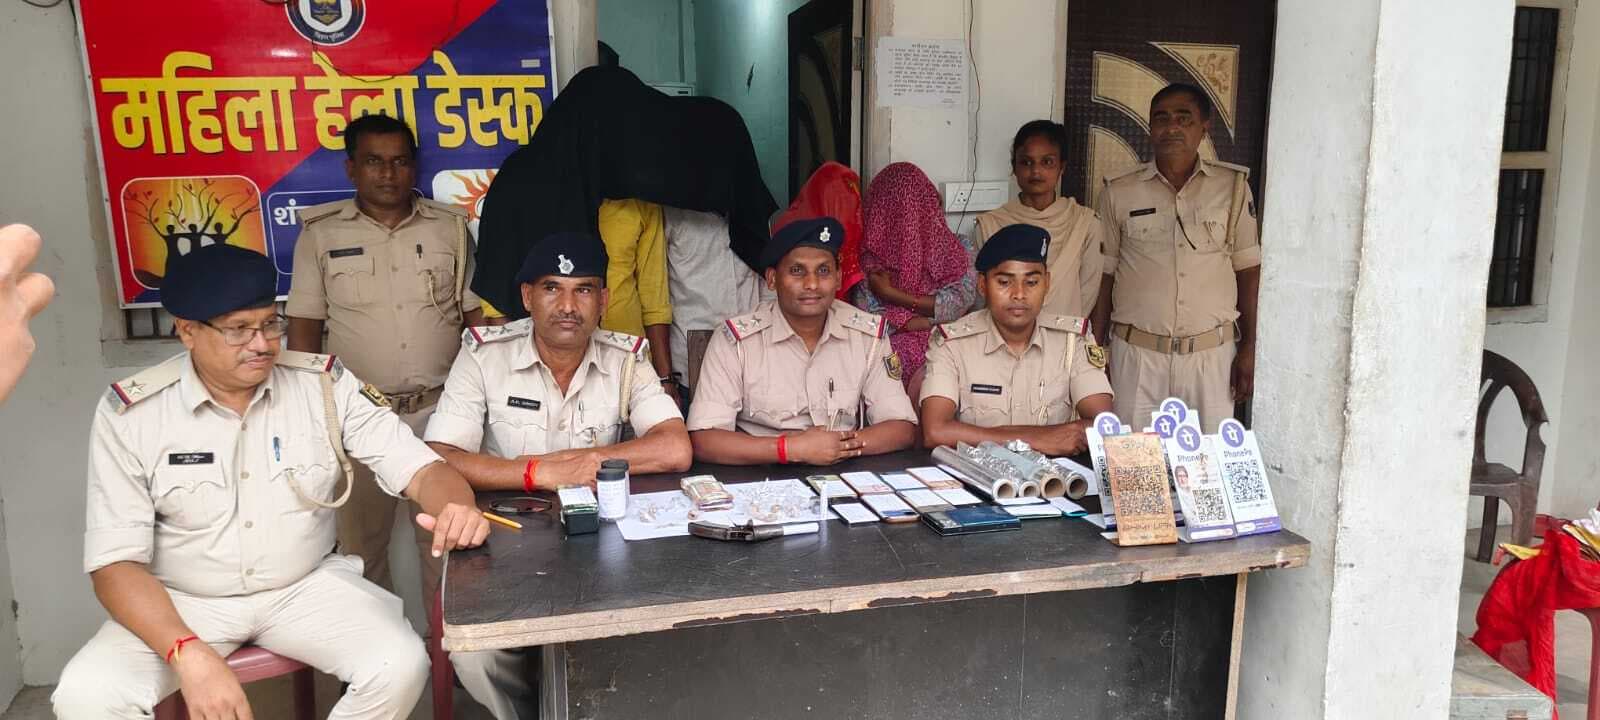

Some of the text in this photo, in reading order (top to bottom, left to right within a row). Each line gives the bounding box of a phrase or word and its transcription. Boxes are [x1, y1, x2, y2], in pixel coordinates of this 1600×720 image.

[100, 51, 297, 154] महिला
[425, 50, 545, 147] डेस्क
[1177, 452, 1208, 463] PhonePe
[1224, 448, 1252, 458] PhonePe
